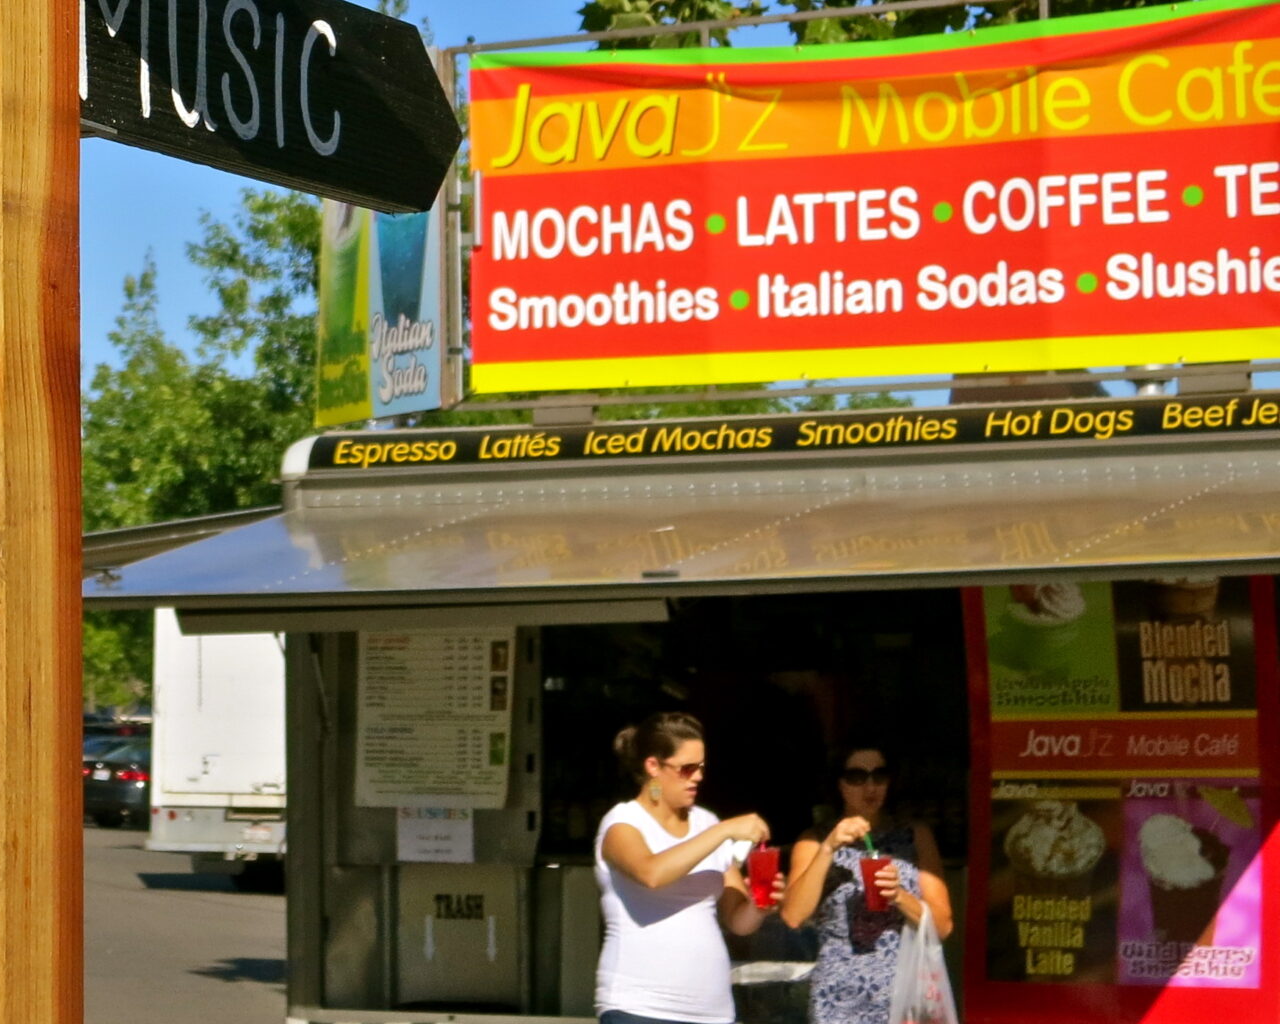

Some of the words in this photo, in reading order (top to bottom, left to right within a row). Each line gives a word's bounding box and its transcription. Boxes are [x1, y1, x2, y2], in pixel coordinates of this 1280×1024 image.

[491, 84, 679, 168] Java
[838, 65, 1091, 149] Mobile
[491, 199, 694, 260] MOCHAS
[736, 186, 920, 248] LATTES
[962, 170, 1169, 234] COFFEE
[489, 280, 718, 331] Smoothies
[757, 270, 902, 319] Italian
[917, 262, 1063, 310] Sodas
[370, 312, 434, 361] Italian
[378, 348, 428, 406] Soda
[334, 440, 456, 469] Espresso
[584, 429, 644, 455] Iced
[651, 424, 772, 452] Mochas
[797, 416, 957, 446] Smoothies
[985, 410, 1041, 437] Hot
[1050, 407, 1133, 440] Dogs
[1162, 399, 1236, 429] Beef
[1140, 621, 1230, 657] Blended
[1143, 660, 1231, 704] Mocha
[1019, 729, 1081, 757] Java
[1127, 734, 1190, 756] Mobile
[1194, 732, 1240, 756] Café
[1127, 779, 1169, 798] Java
[434, 894, 484, 920] TRASH
[1014, 896, 1091, 921] Blended
[1019, 921, 1084, 948] Vanilla
[1026, 948, 1075, 975] Latte
